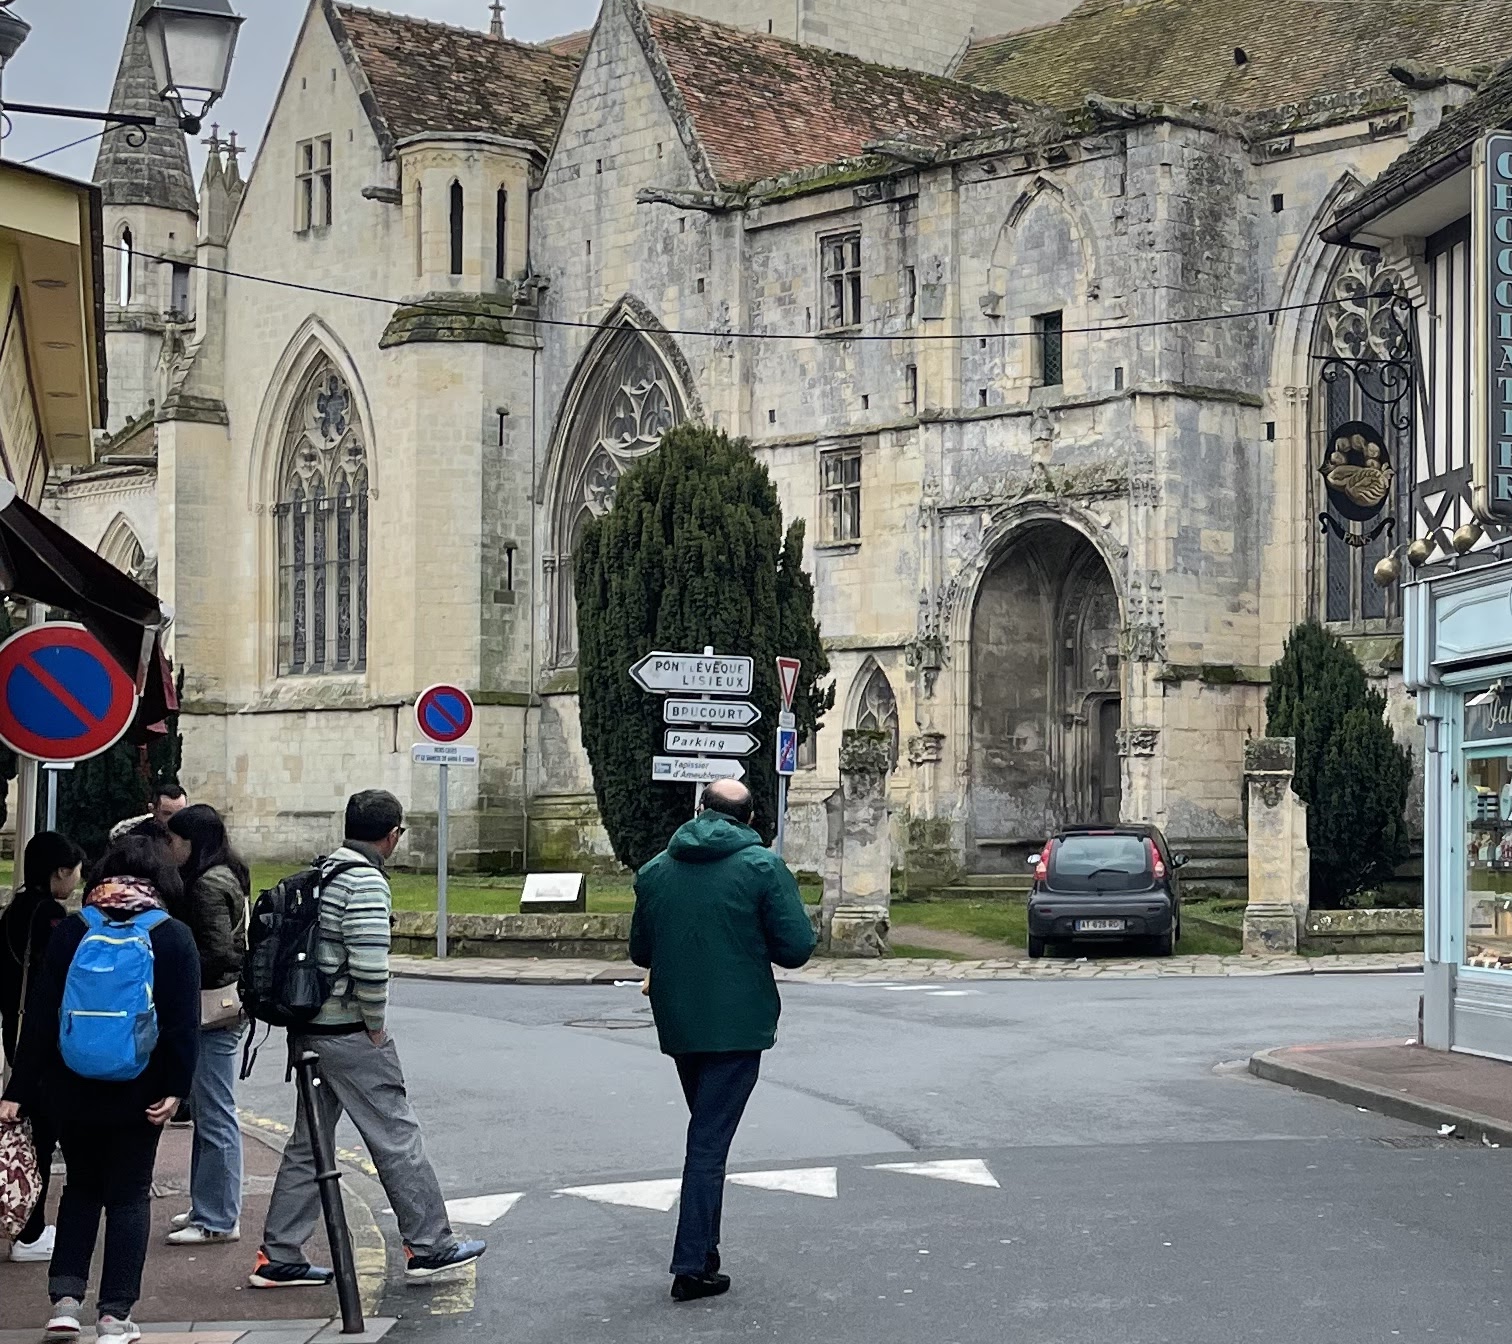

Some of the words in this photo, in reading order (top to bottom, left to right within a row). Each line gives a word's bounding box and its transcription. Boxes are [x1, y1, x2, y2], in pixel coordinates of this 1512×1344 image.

[1343, 531, 1372, 547] PAINS
[655, 660, 686, 672] PONT
[682, 675, 743, 688] LISIEUX
[672, 735, 725, 750] Parking
[674, 759, 710, 770] Tapissier
